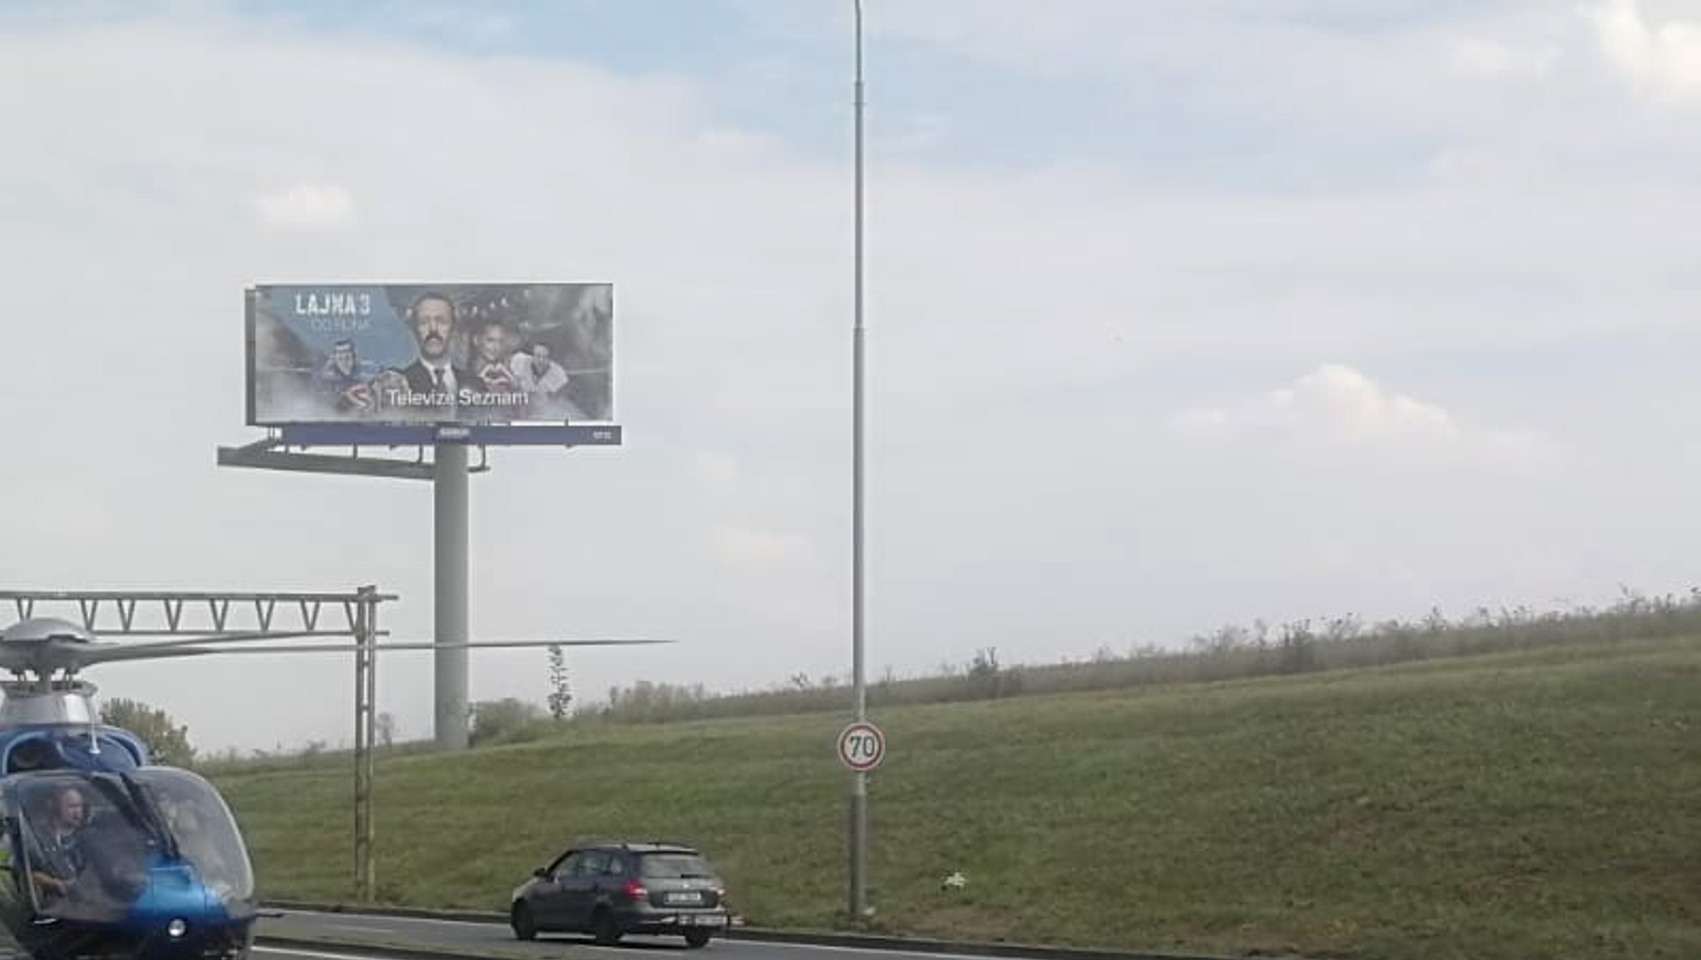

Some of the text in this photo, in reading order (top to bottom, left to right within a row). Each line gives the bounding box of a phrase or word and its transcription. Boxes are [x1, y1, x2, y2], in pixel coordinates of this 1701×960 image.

[359, 293, 371, 315] 3
[386, 388, 530, 406] Televize Seznam
[849, 735, 876, 759] 70
